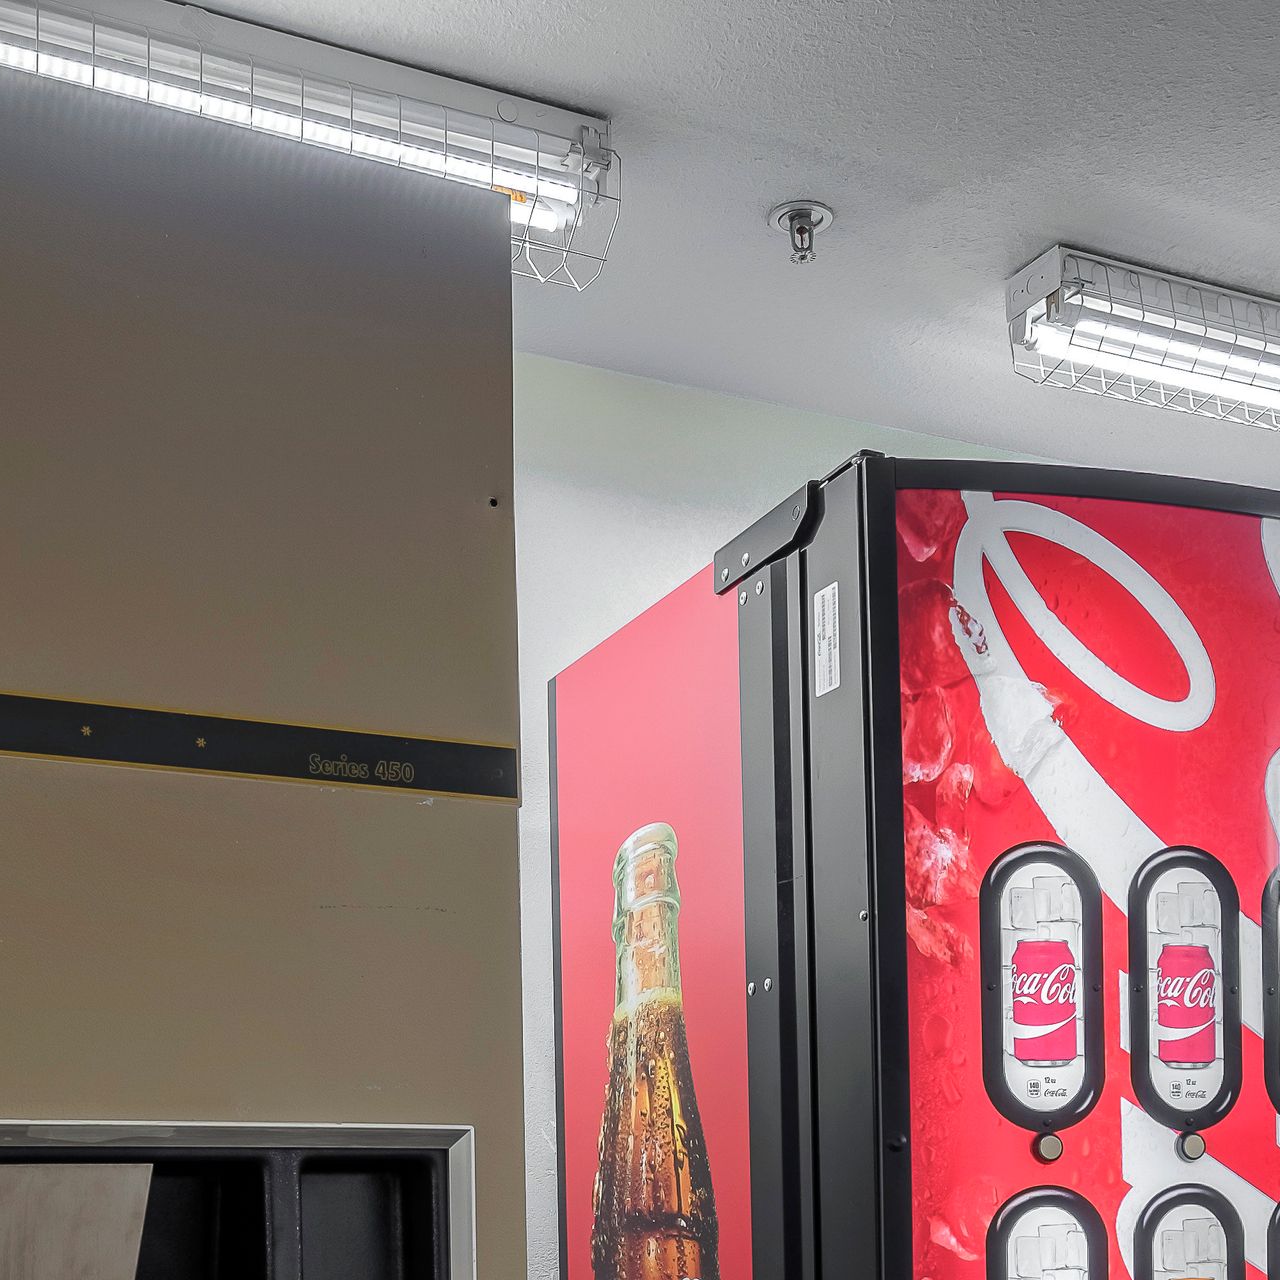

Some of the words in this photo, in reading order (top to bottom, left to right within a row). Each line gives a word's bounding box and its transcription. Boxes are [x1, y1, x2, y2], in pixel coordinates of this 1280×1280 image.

[309, 753, 370, 779] Series
[375, 760, 415, 782] 450
[1011, 964, 1076, 1004] oca-Col
[1157, 967, 1216, 1008] oca-Col
